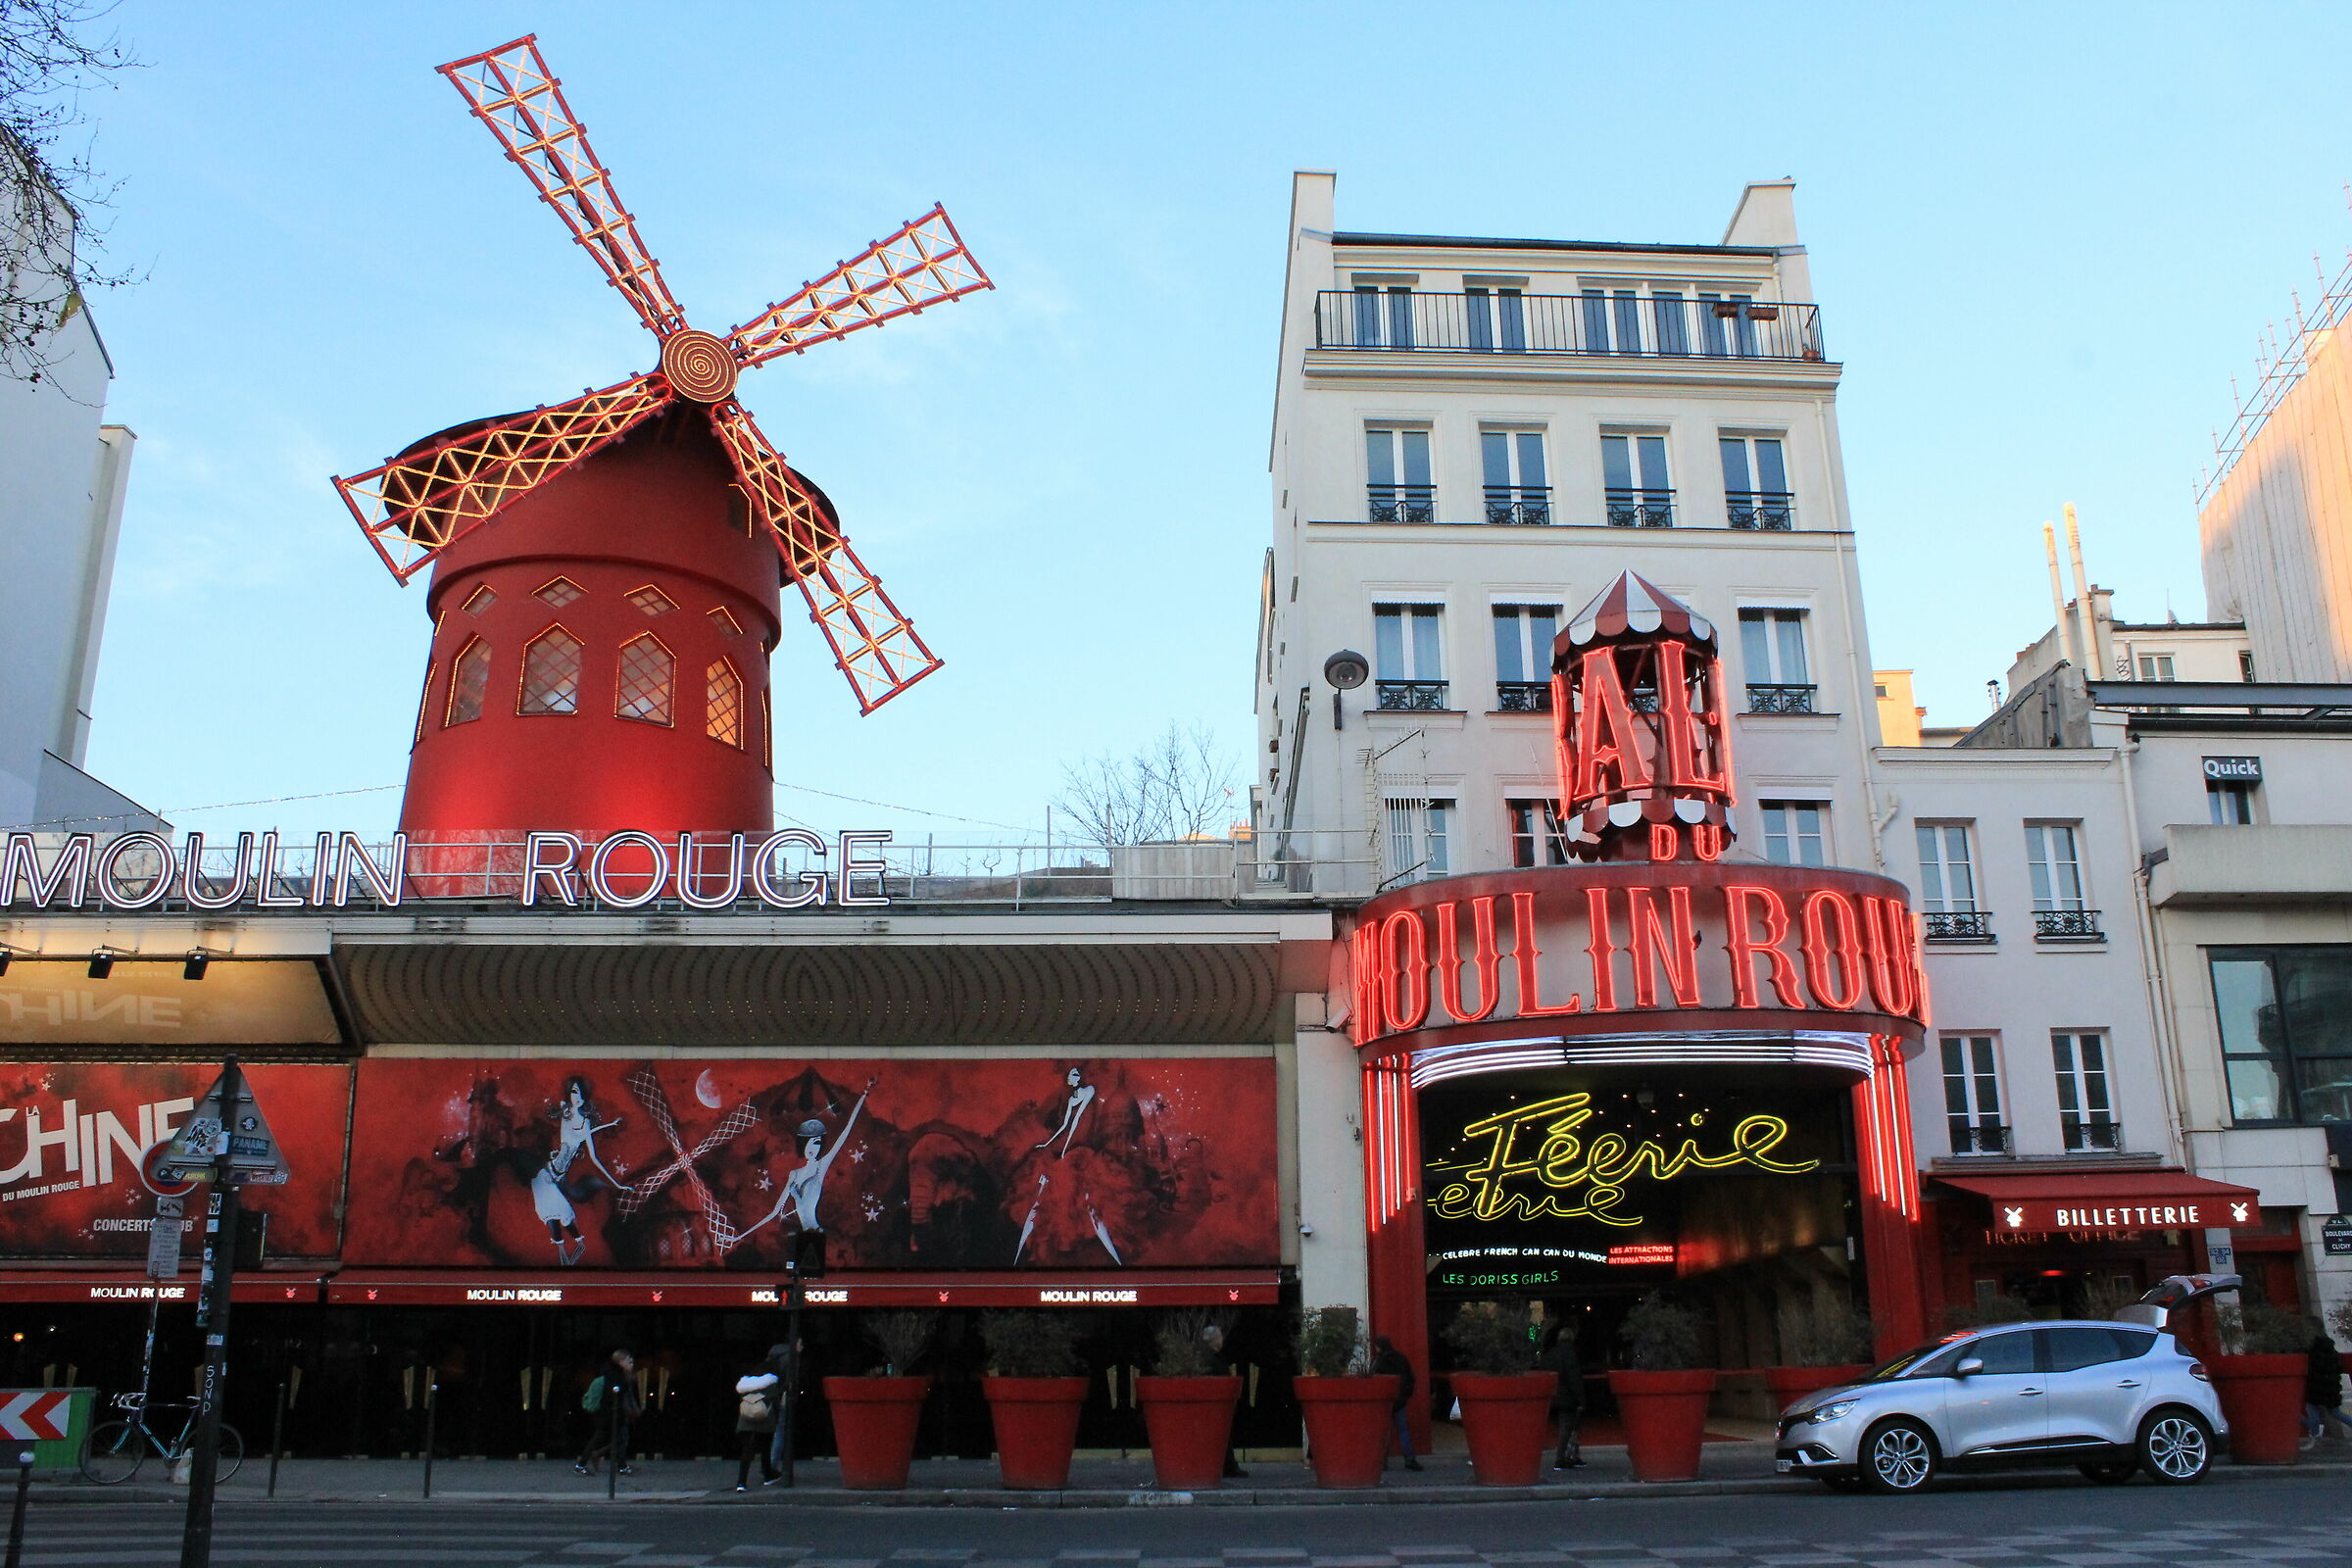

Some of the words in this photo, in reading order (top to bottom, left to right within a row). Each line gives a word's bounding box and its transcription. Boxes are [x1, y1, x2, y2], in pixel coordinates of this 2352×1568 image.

[2204, 758, 2259, 778] Quick
[1651, 823, 1722, 862] DU
[0, 830, 409, 909] MOULIN
[521, 829, 893, 909] ROUGE
[1353, 885, 1701, 1047] MOULIN
[26, 1104, 40, 1117] LA
[1464, 1092, 1820, 1216] Féerie
[2, 1193, 15, 1202] DU
[17, 1186, 50, 1199] MOULIN
[51, 1180, 80, 1193] ROUGE
[2056, 1205, 2200, 1226] BILLETTERIE
[1484, 1247, 1518, 1256] FRENCH
[1522, 1247, 1540, 1256] CAN
[1544, 1248, 1560, 1256] CAN
[1562, 1249, 1575, 1258] DU
[1578, 1250, 1607, 1263] MONDE
[1623, 1245, 1674, 1253] ATTRACTIONS
[1608, 1254, 1674, 1264] INTERNATIONALES
[1443, 1273, 1464, 1285] LES
[1470, 1273, 1519, 1286] DORISS
[1521, 1270, 1559, 1286] GIRLS
[90, 1287, 139, 1298] MOULIN
[466, 1289, 516, 1300] MOULIN
[516, 1289, 563, 1301] ROUGE
[804, 1290, 849, 1302] ROUGE
[1040, 1291, 1091, 1302] MOULIN
[1092, 1290, 1138, 1302] ROUGE
